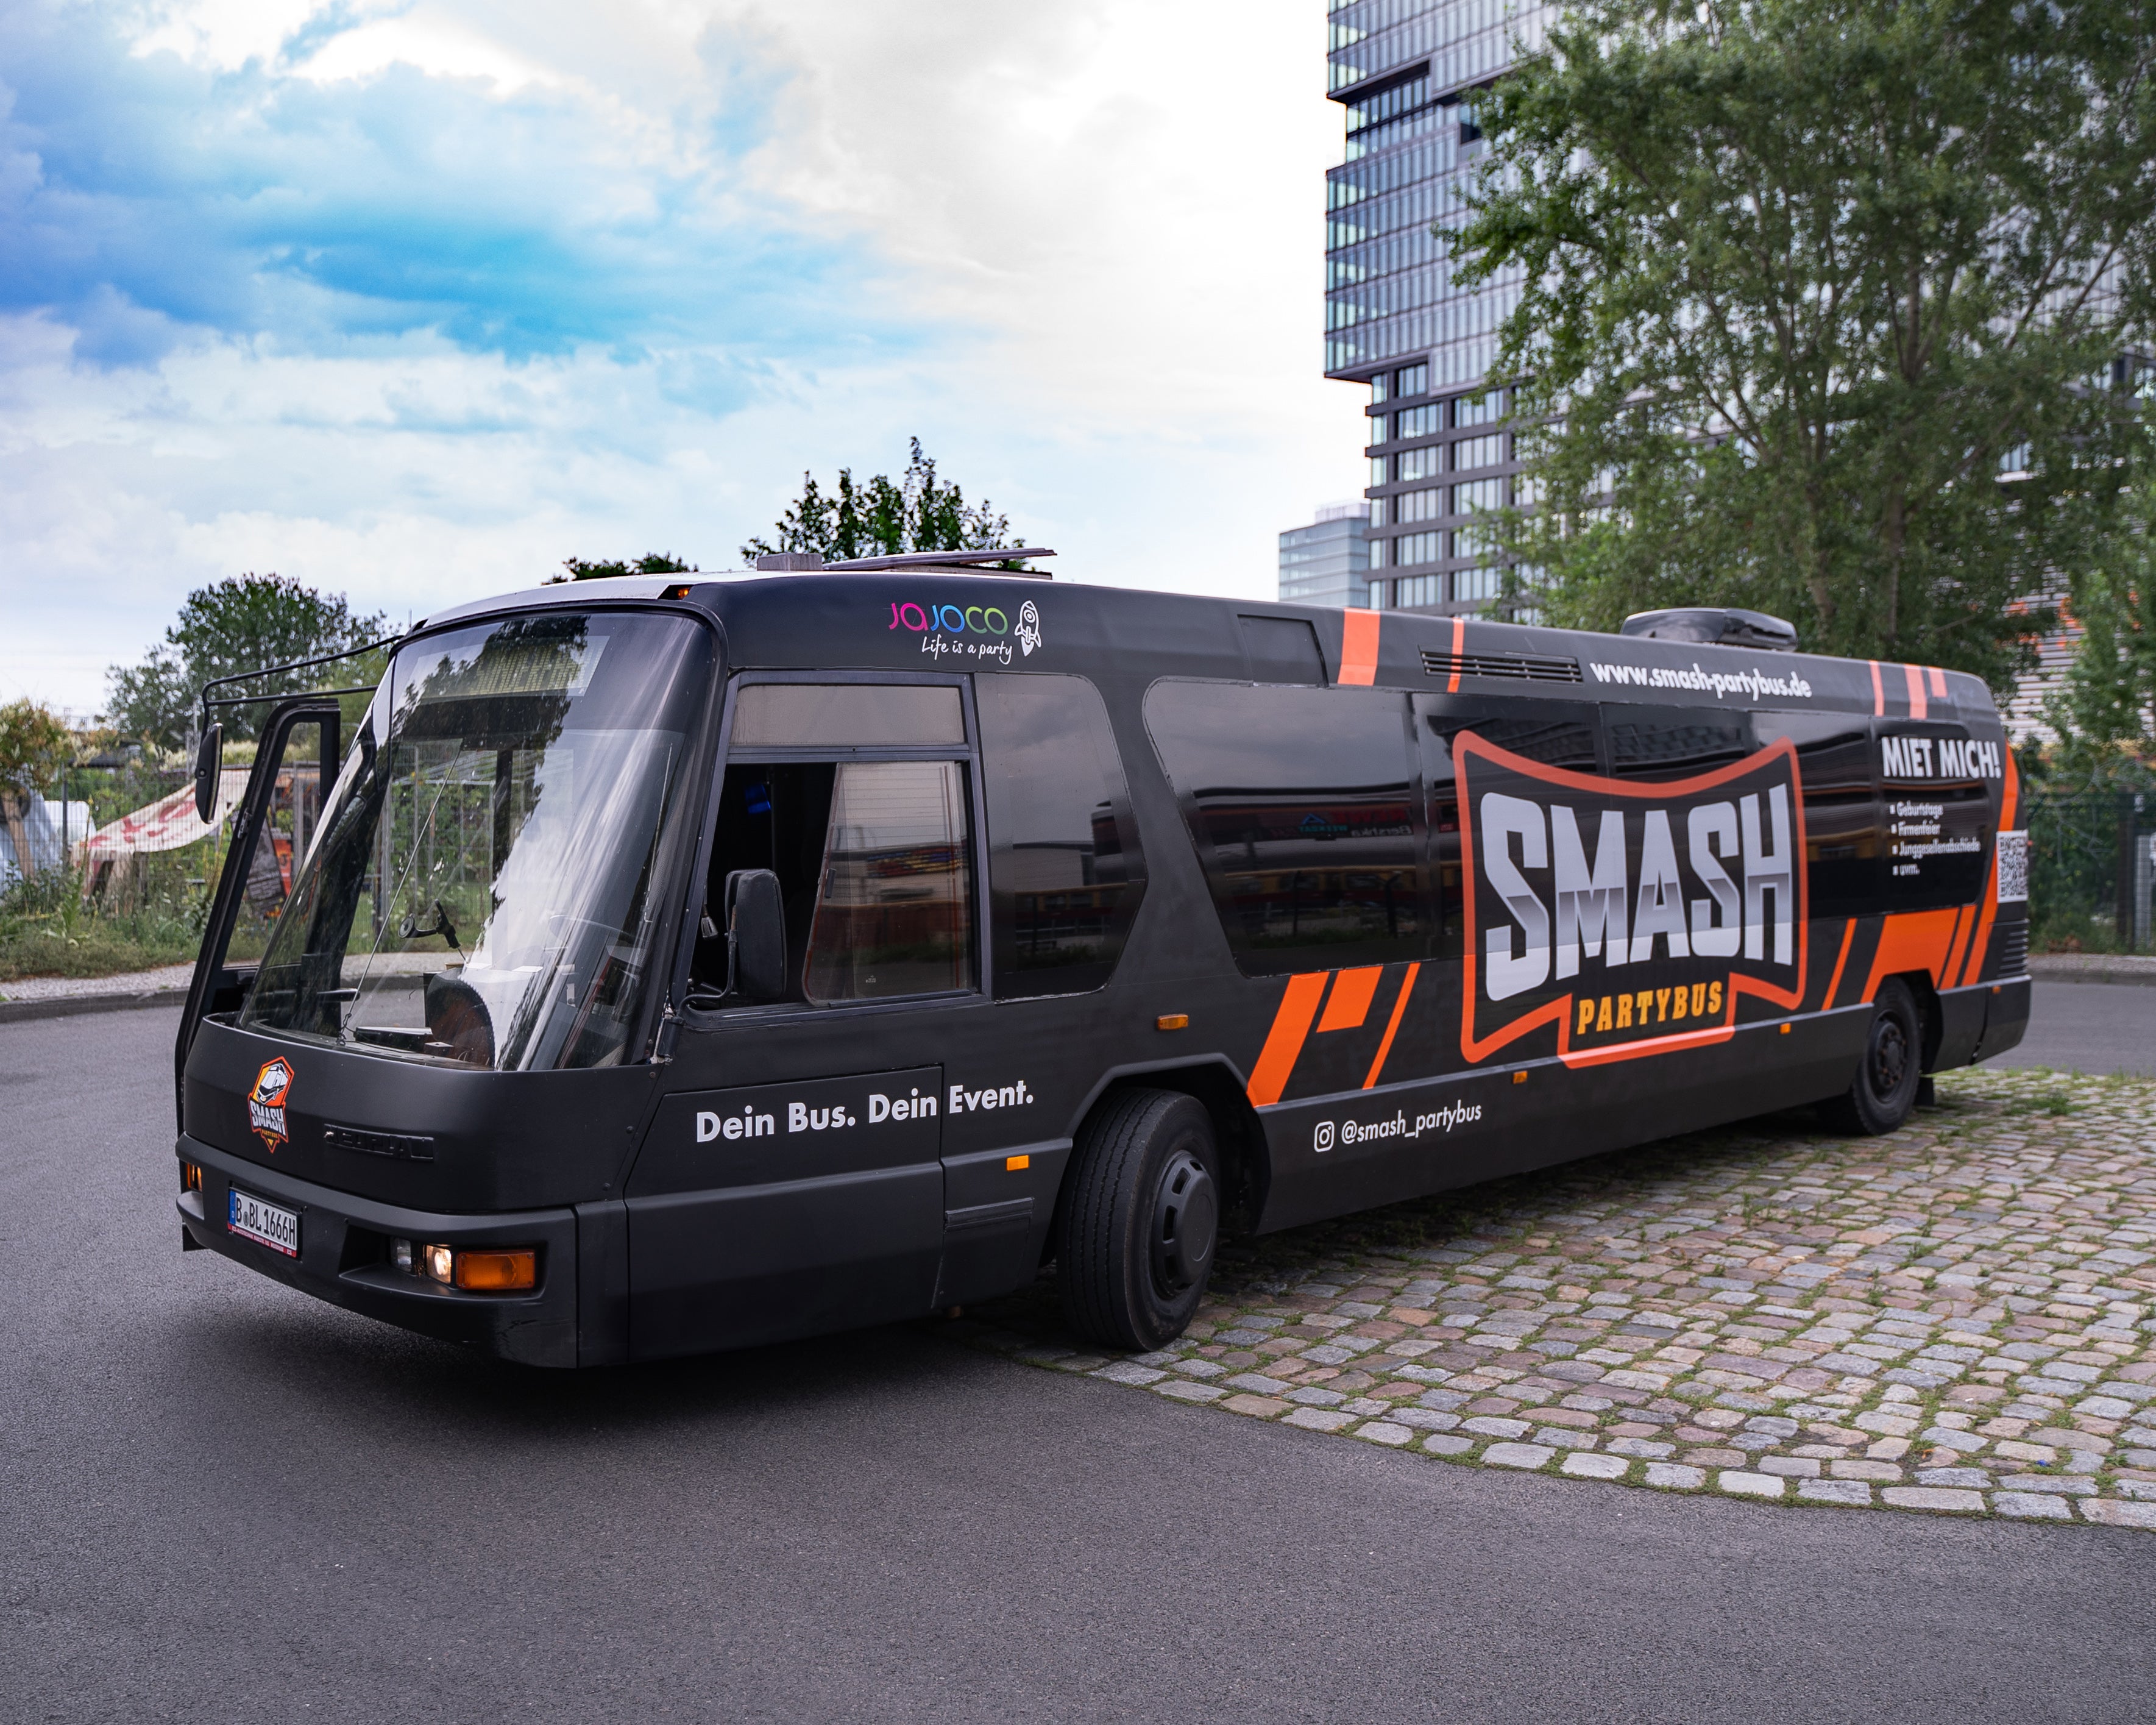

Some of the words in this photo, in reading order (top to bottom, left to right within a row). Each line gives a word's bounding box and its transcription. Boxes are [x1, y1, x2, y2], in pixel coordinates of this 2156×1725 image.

[921, 633, 949, 661] Life
[952, 641, 963, 654] is
[967, 643, 977, 654] a
[979, 641, 1013, 665] party
[1589, 662, 1813, 702] www.smash-partybus.de
[1881, 736, 1934, 778] MIET
[1938, 739, 2002, 779] MICH!
[1896, 800, 1944, 820] Geburtstage
[1899, 837, 1981, 859] Junggesellenabschiede
[1481, 783, 1793, 1001] SMASH
[1576, 980, 1722, 1035] PARTYBUS
[249, 1100, 286, 1137] SMASH
[697, 1104, 775, 1143] Dein
[789, 1102, 856, 1133] Bus.
[869, 1087, 937, 1123] Dein
[949, 1079, 1034, 1114] Event.
[1341, 1099, 1482, 1145] @smash_partybus
[236, 1197, 242, 1223] B
[249, 1201, 262, 1232] BL
[263, 1208, 296, 1247] 1666H
